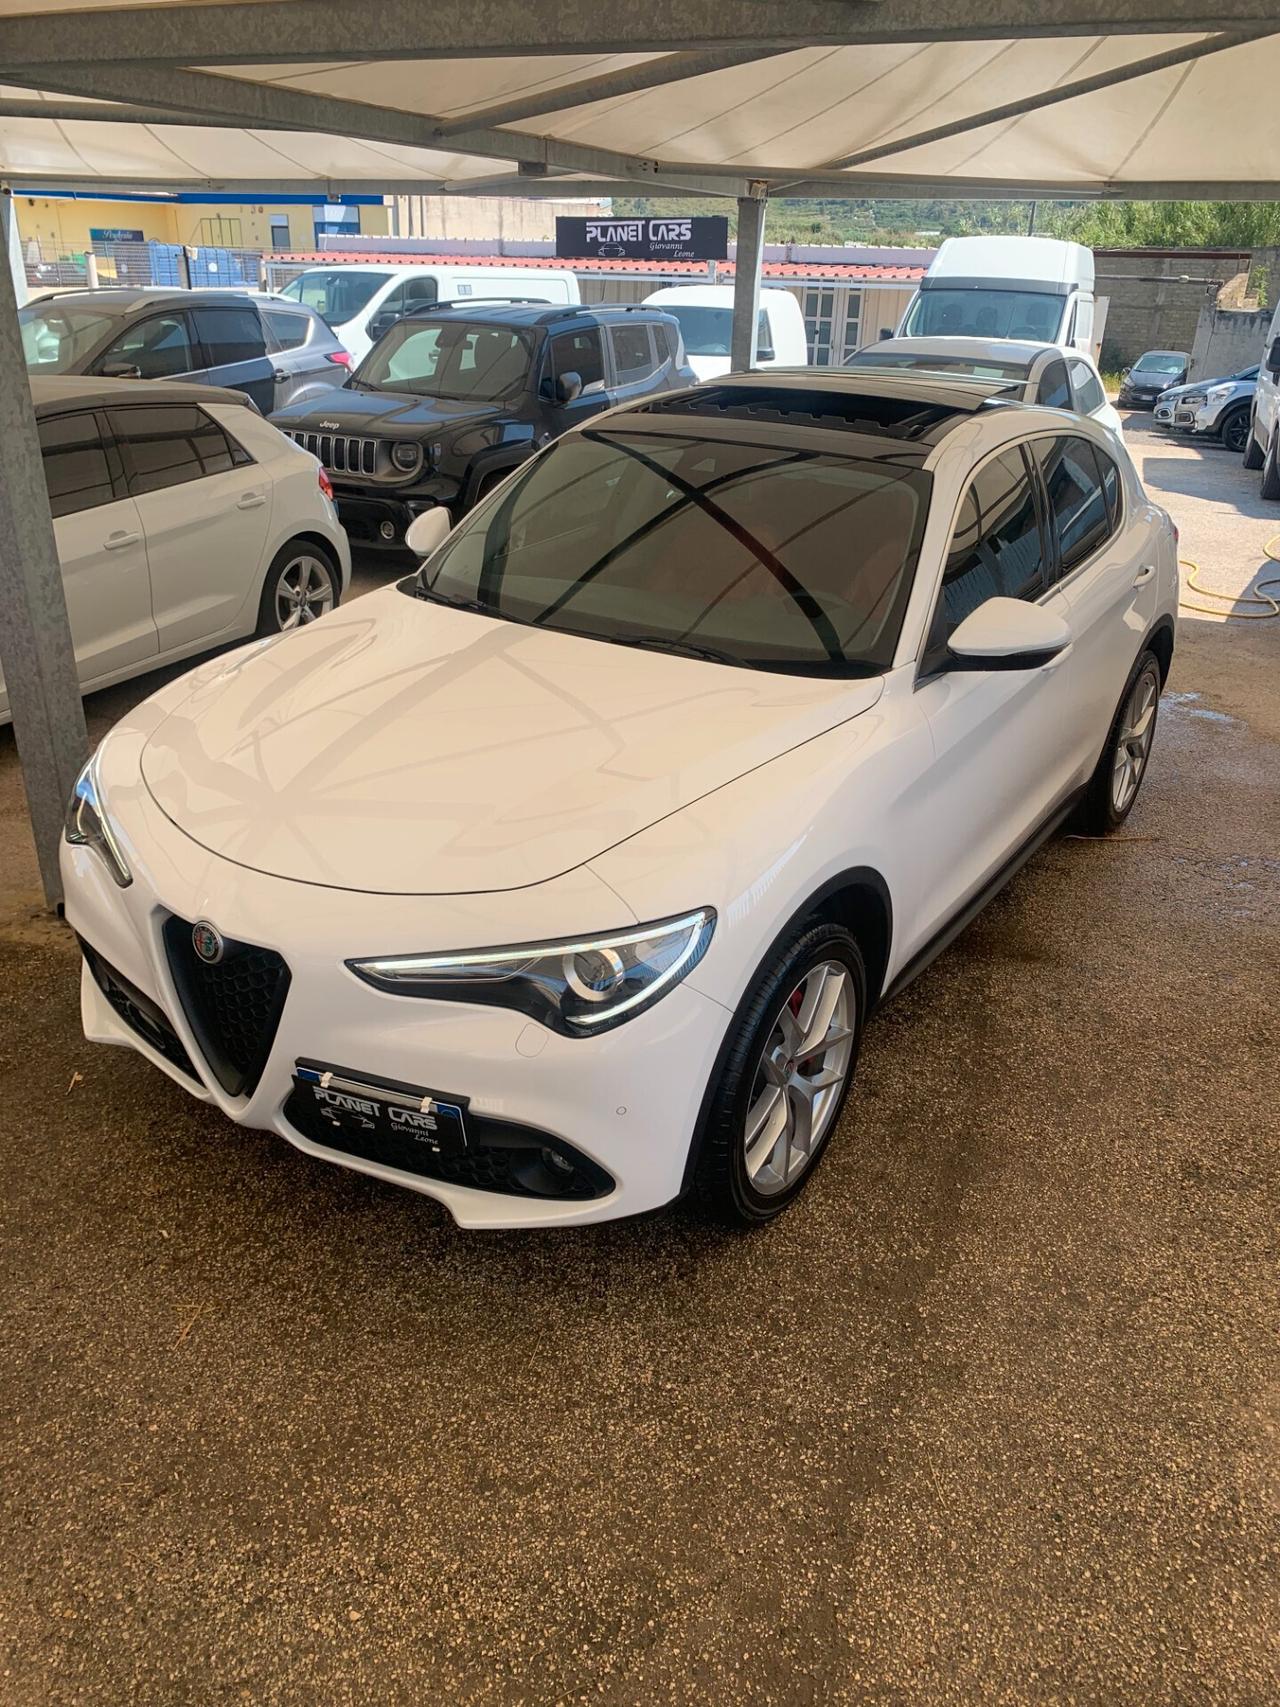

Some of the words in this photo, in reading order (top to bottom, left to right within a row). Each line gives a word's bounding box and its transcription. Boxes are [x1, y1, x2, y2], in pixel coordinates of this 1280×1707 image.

[586, 220, 645, 243] PLANET
[649, 219, 692, 241] CARS
[649, 242, 683, 251] Giovanni
[673, 250, 695, 258] Leone
[319, 420, 340, 430] Jeep
[313, 1086, 380, 1117] PLANET
[388, 1106, 438, 1130] CARS
[390, 1122, 429, 1137] Giovanni
[414, 1134, 439, 1145] Leone
